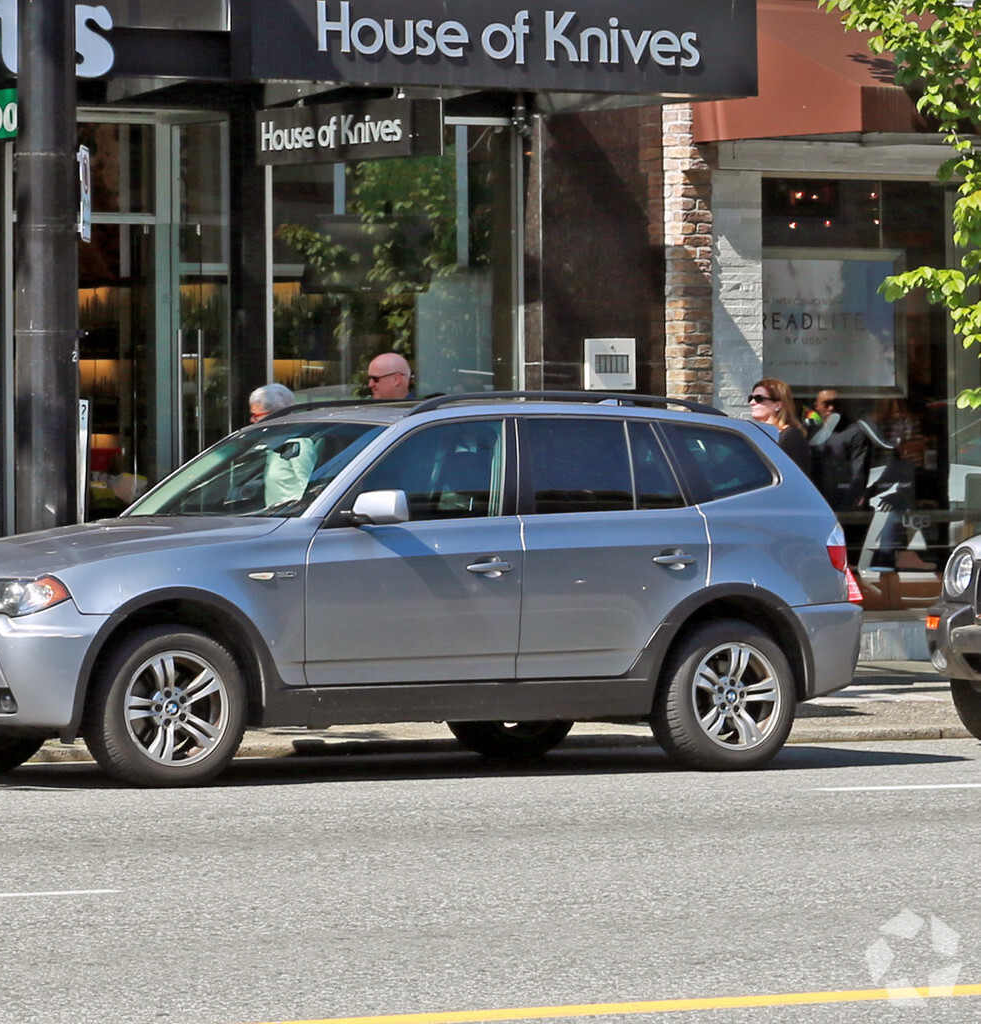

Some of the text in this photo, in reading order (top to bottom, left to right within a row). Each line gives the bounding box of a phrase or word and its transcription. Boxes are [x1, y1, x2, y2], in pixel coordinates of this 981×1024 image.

[317, 0, 701, 67] House of Knives
[261, 114, 402, 151] House of Knives
